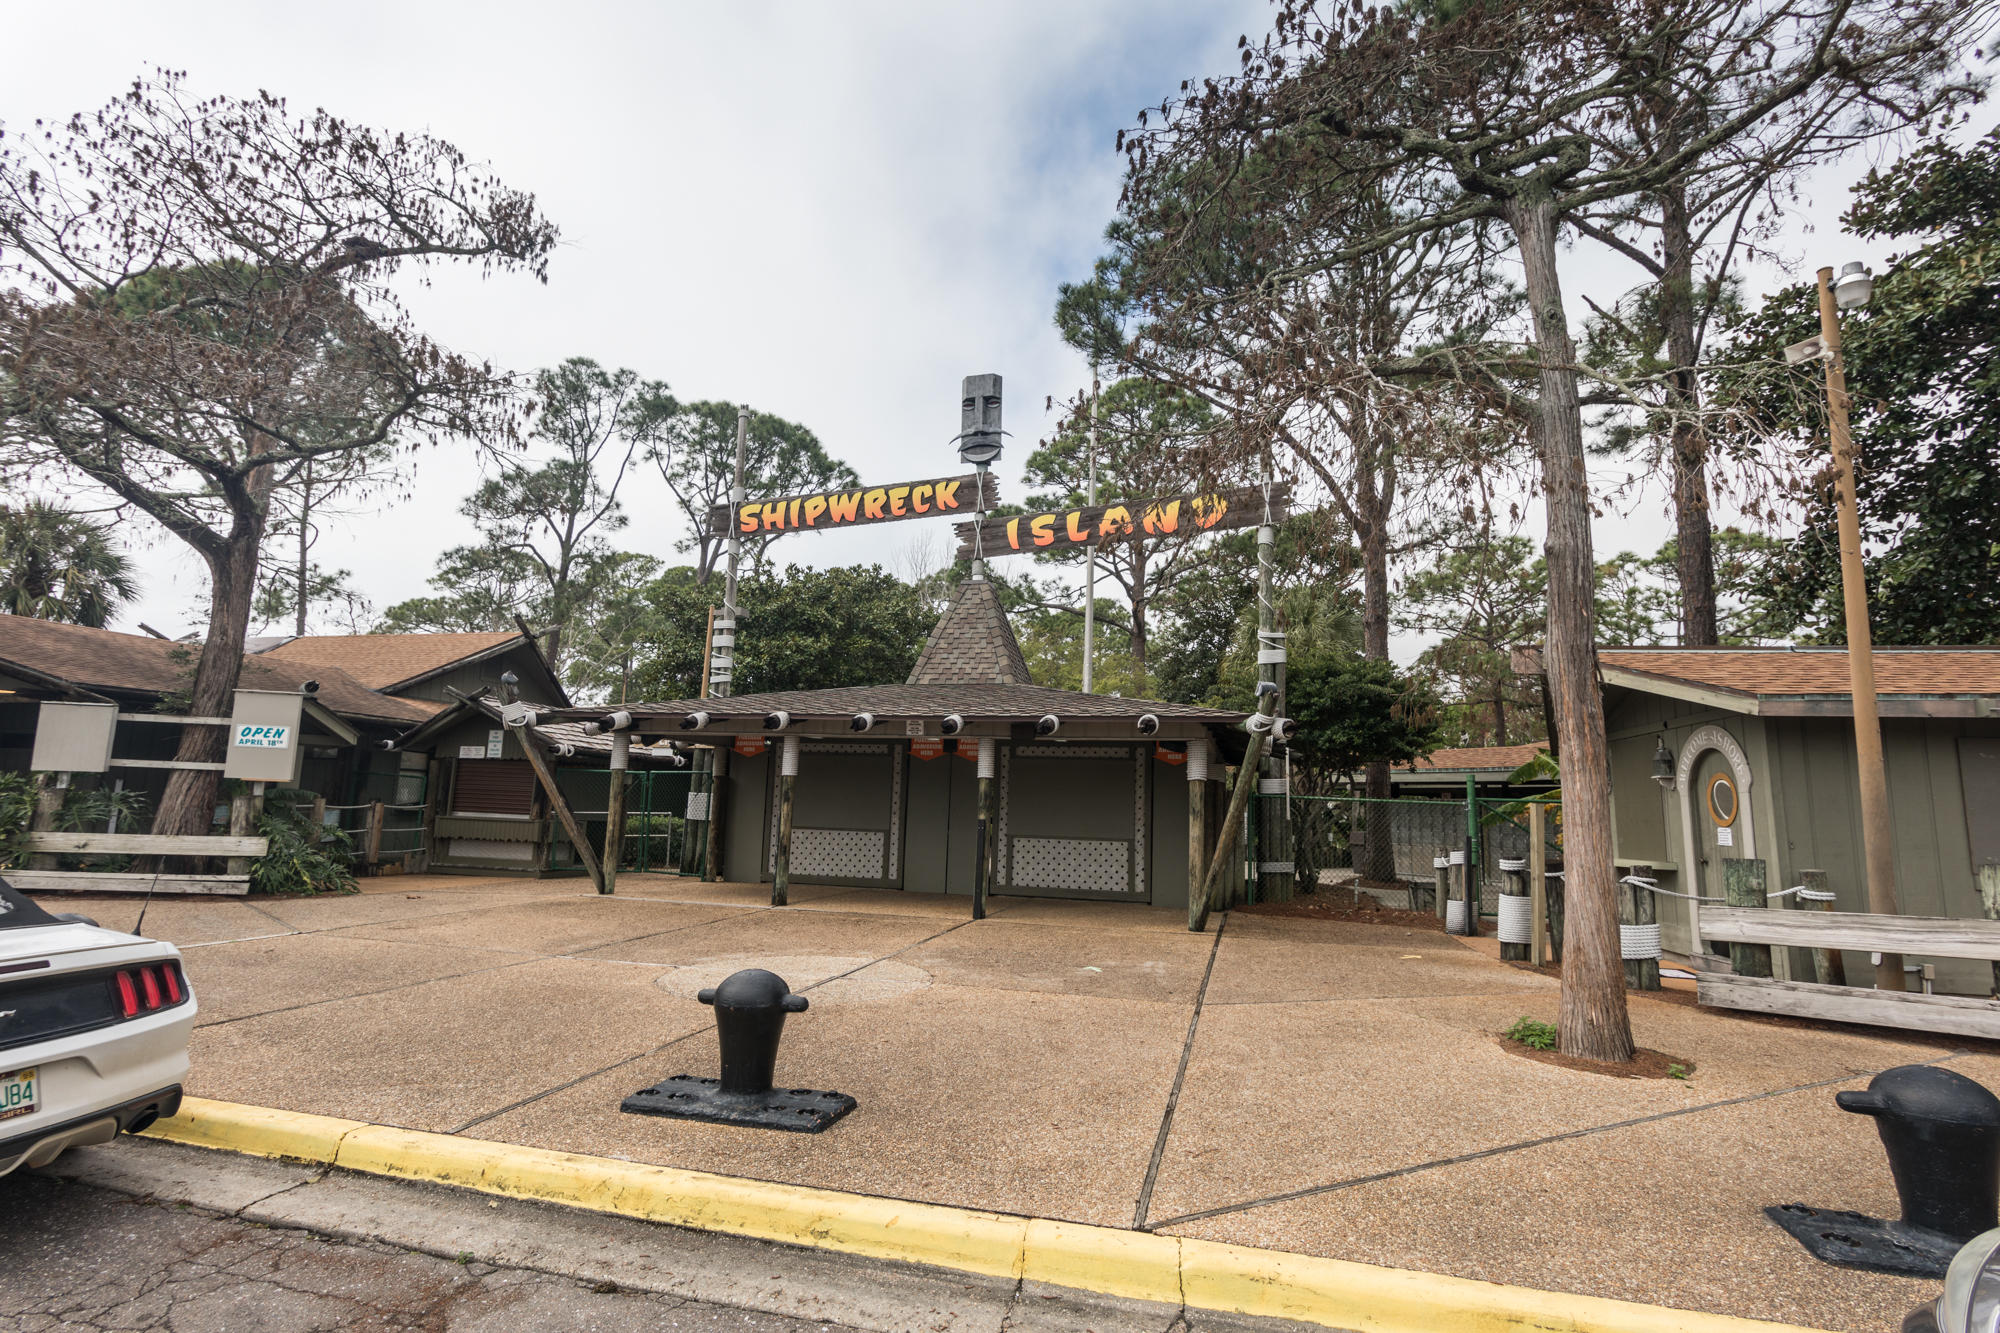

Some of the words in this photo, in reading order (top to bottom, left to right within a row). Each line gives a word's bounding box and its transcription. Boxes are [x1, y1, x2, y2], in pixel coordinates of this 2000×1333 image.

[739, 481, 961, 533] SHIPWRECK
[1006, 493, 1228, 550] ISLAND
[238, 738, 264, 746] APRIL
[240, 726, 285, 739] OPEN
[1679, 730, 1707, 782] WELCOME
[1709, 730, 1745, 775] ASHORE
